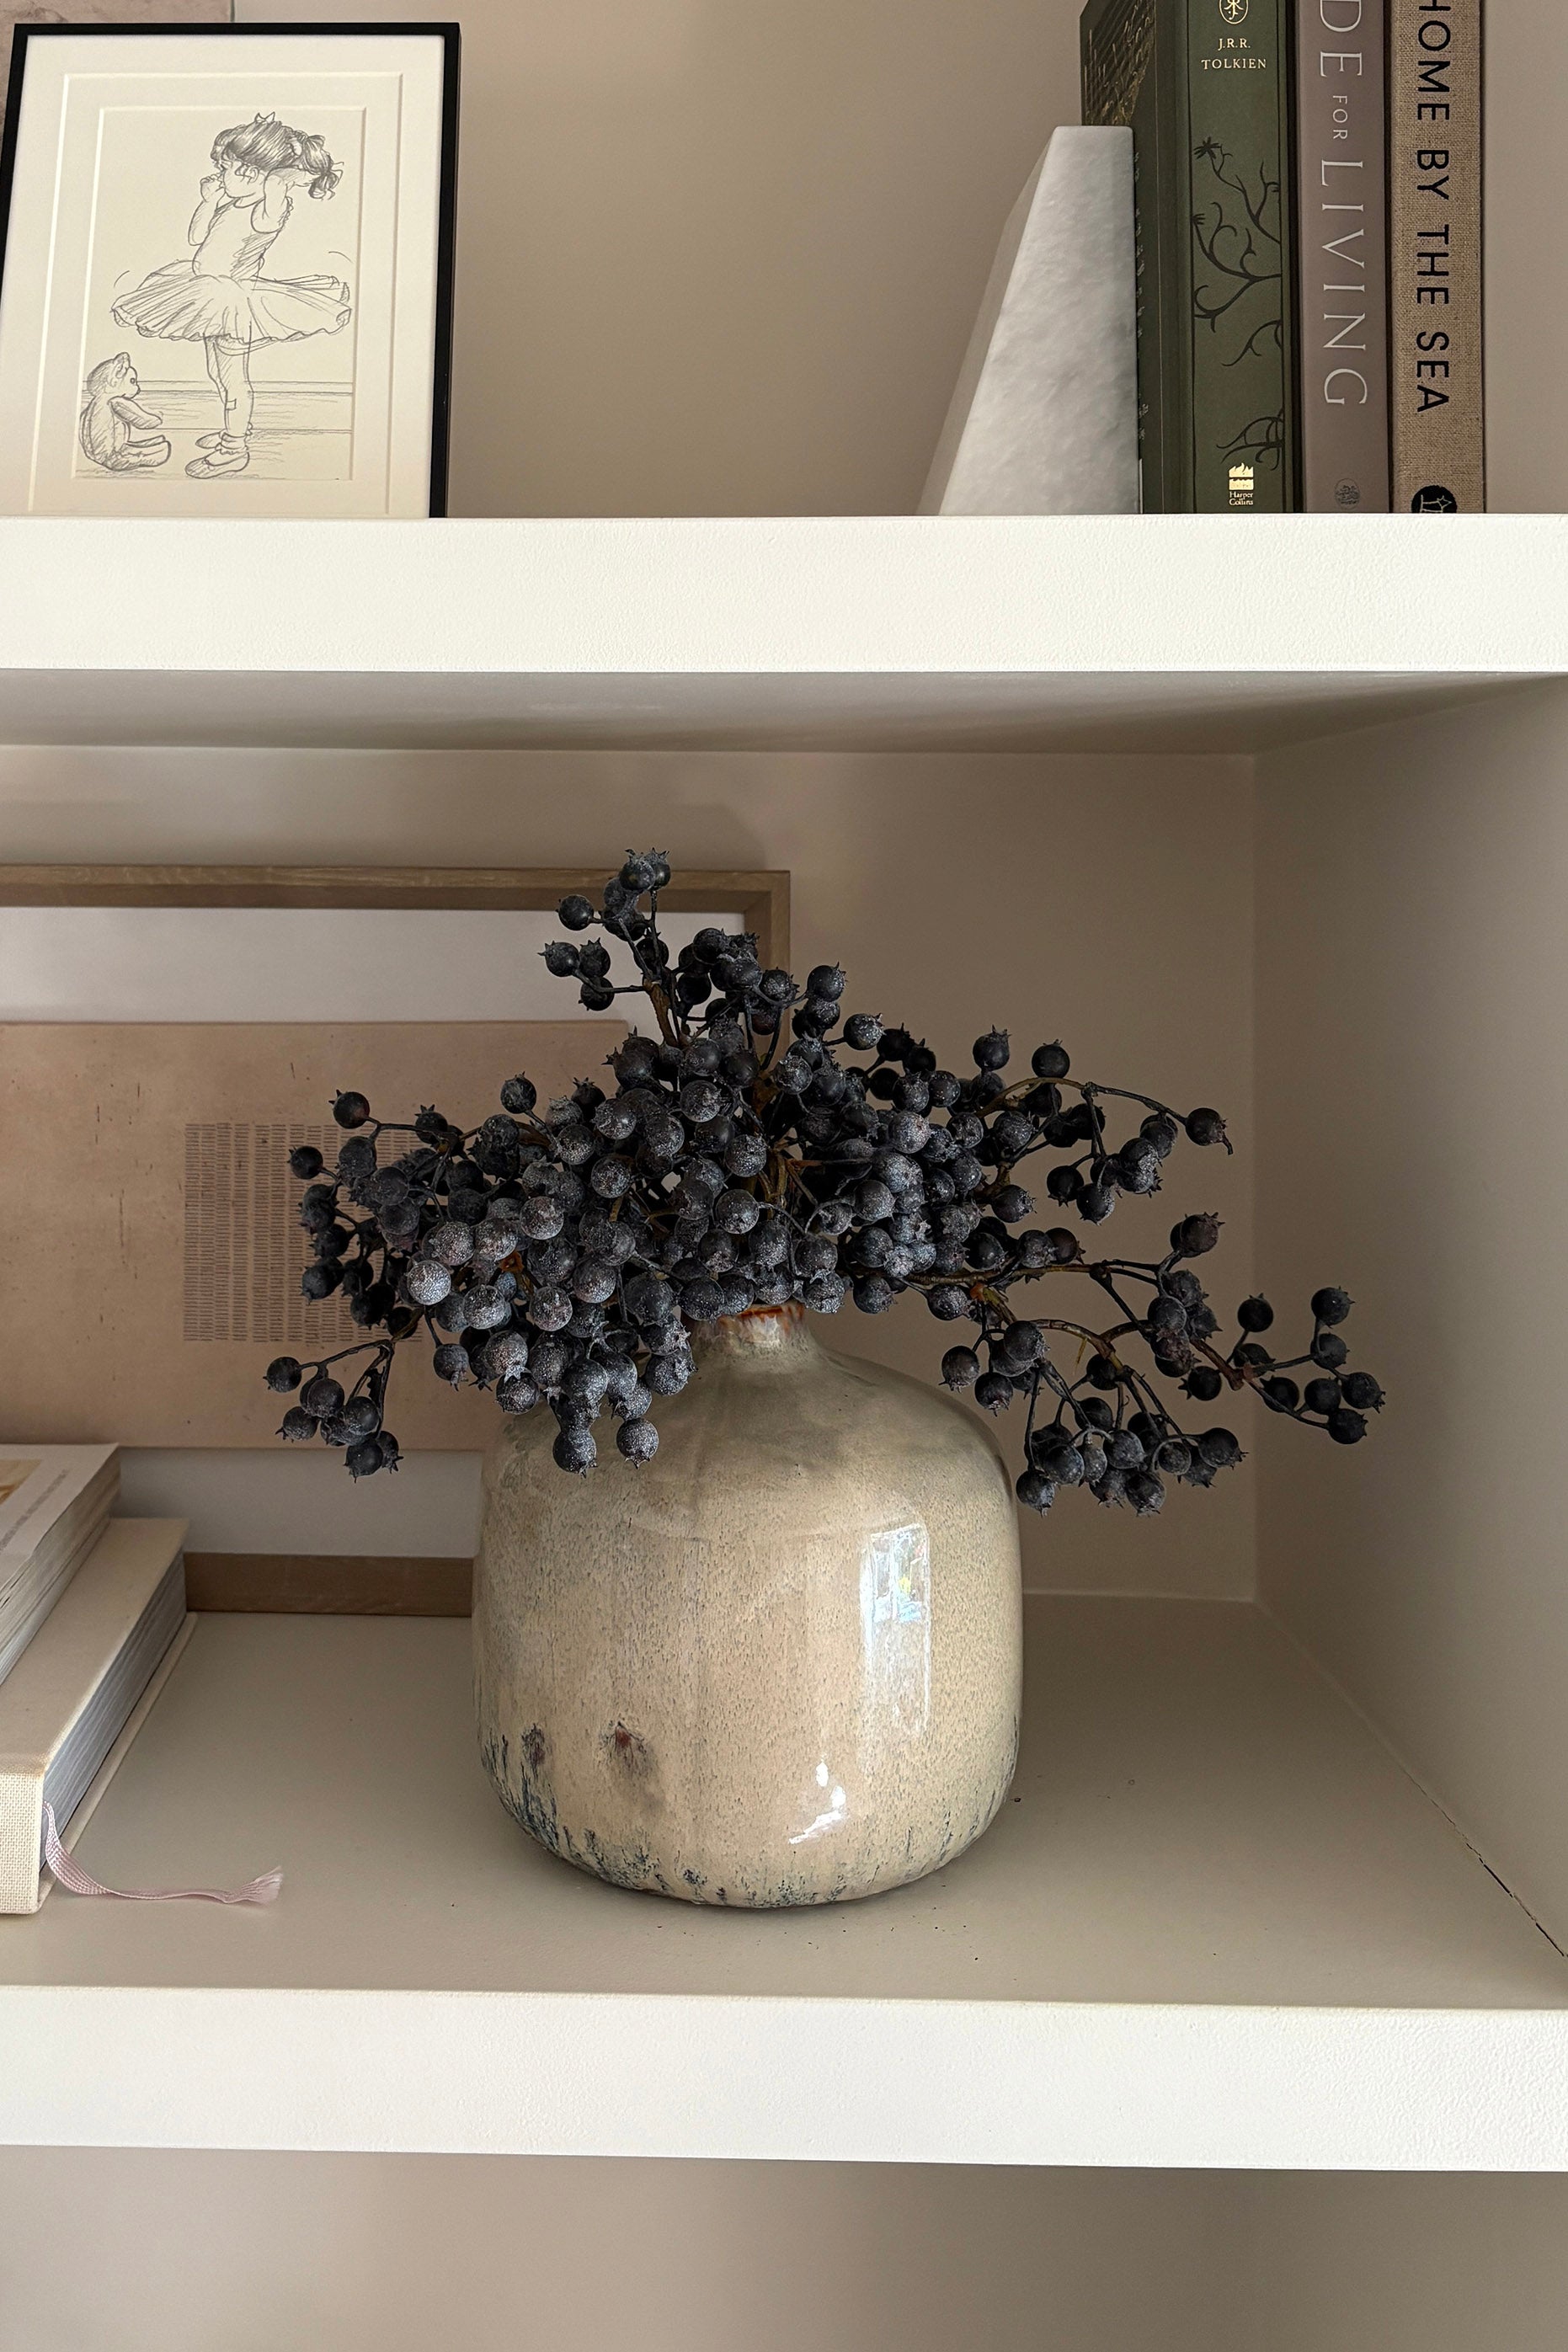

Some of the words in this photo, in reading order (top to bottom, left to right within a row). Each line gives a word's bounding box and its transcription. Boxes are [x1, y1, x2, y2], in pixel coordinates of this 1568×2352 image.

[1201, 58, 1267, 70] TOLKIEN
[1218, 38, 1251, 51] J.R.R.
[1332, 95, 1348, 140] FOR
[1416, 149, 1449, 200] BY
[1321, 159, 1368, 405] LIVING
[1416, 224, 1449, 304] THE
[1416, 331, 1449, 413] SEA
[1229, 491, 1254, 500] Harper
